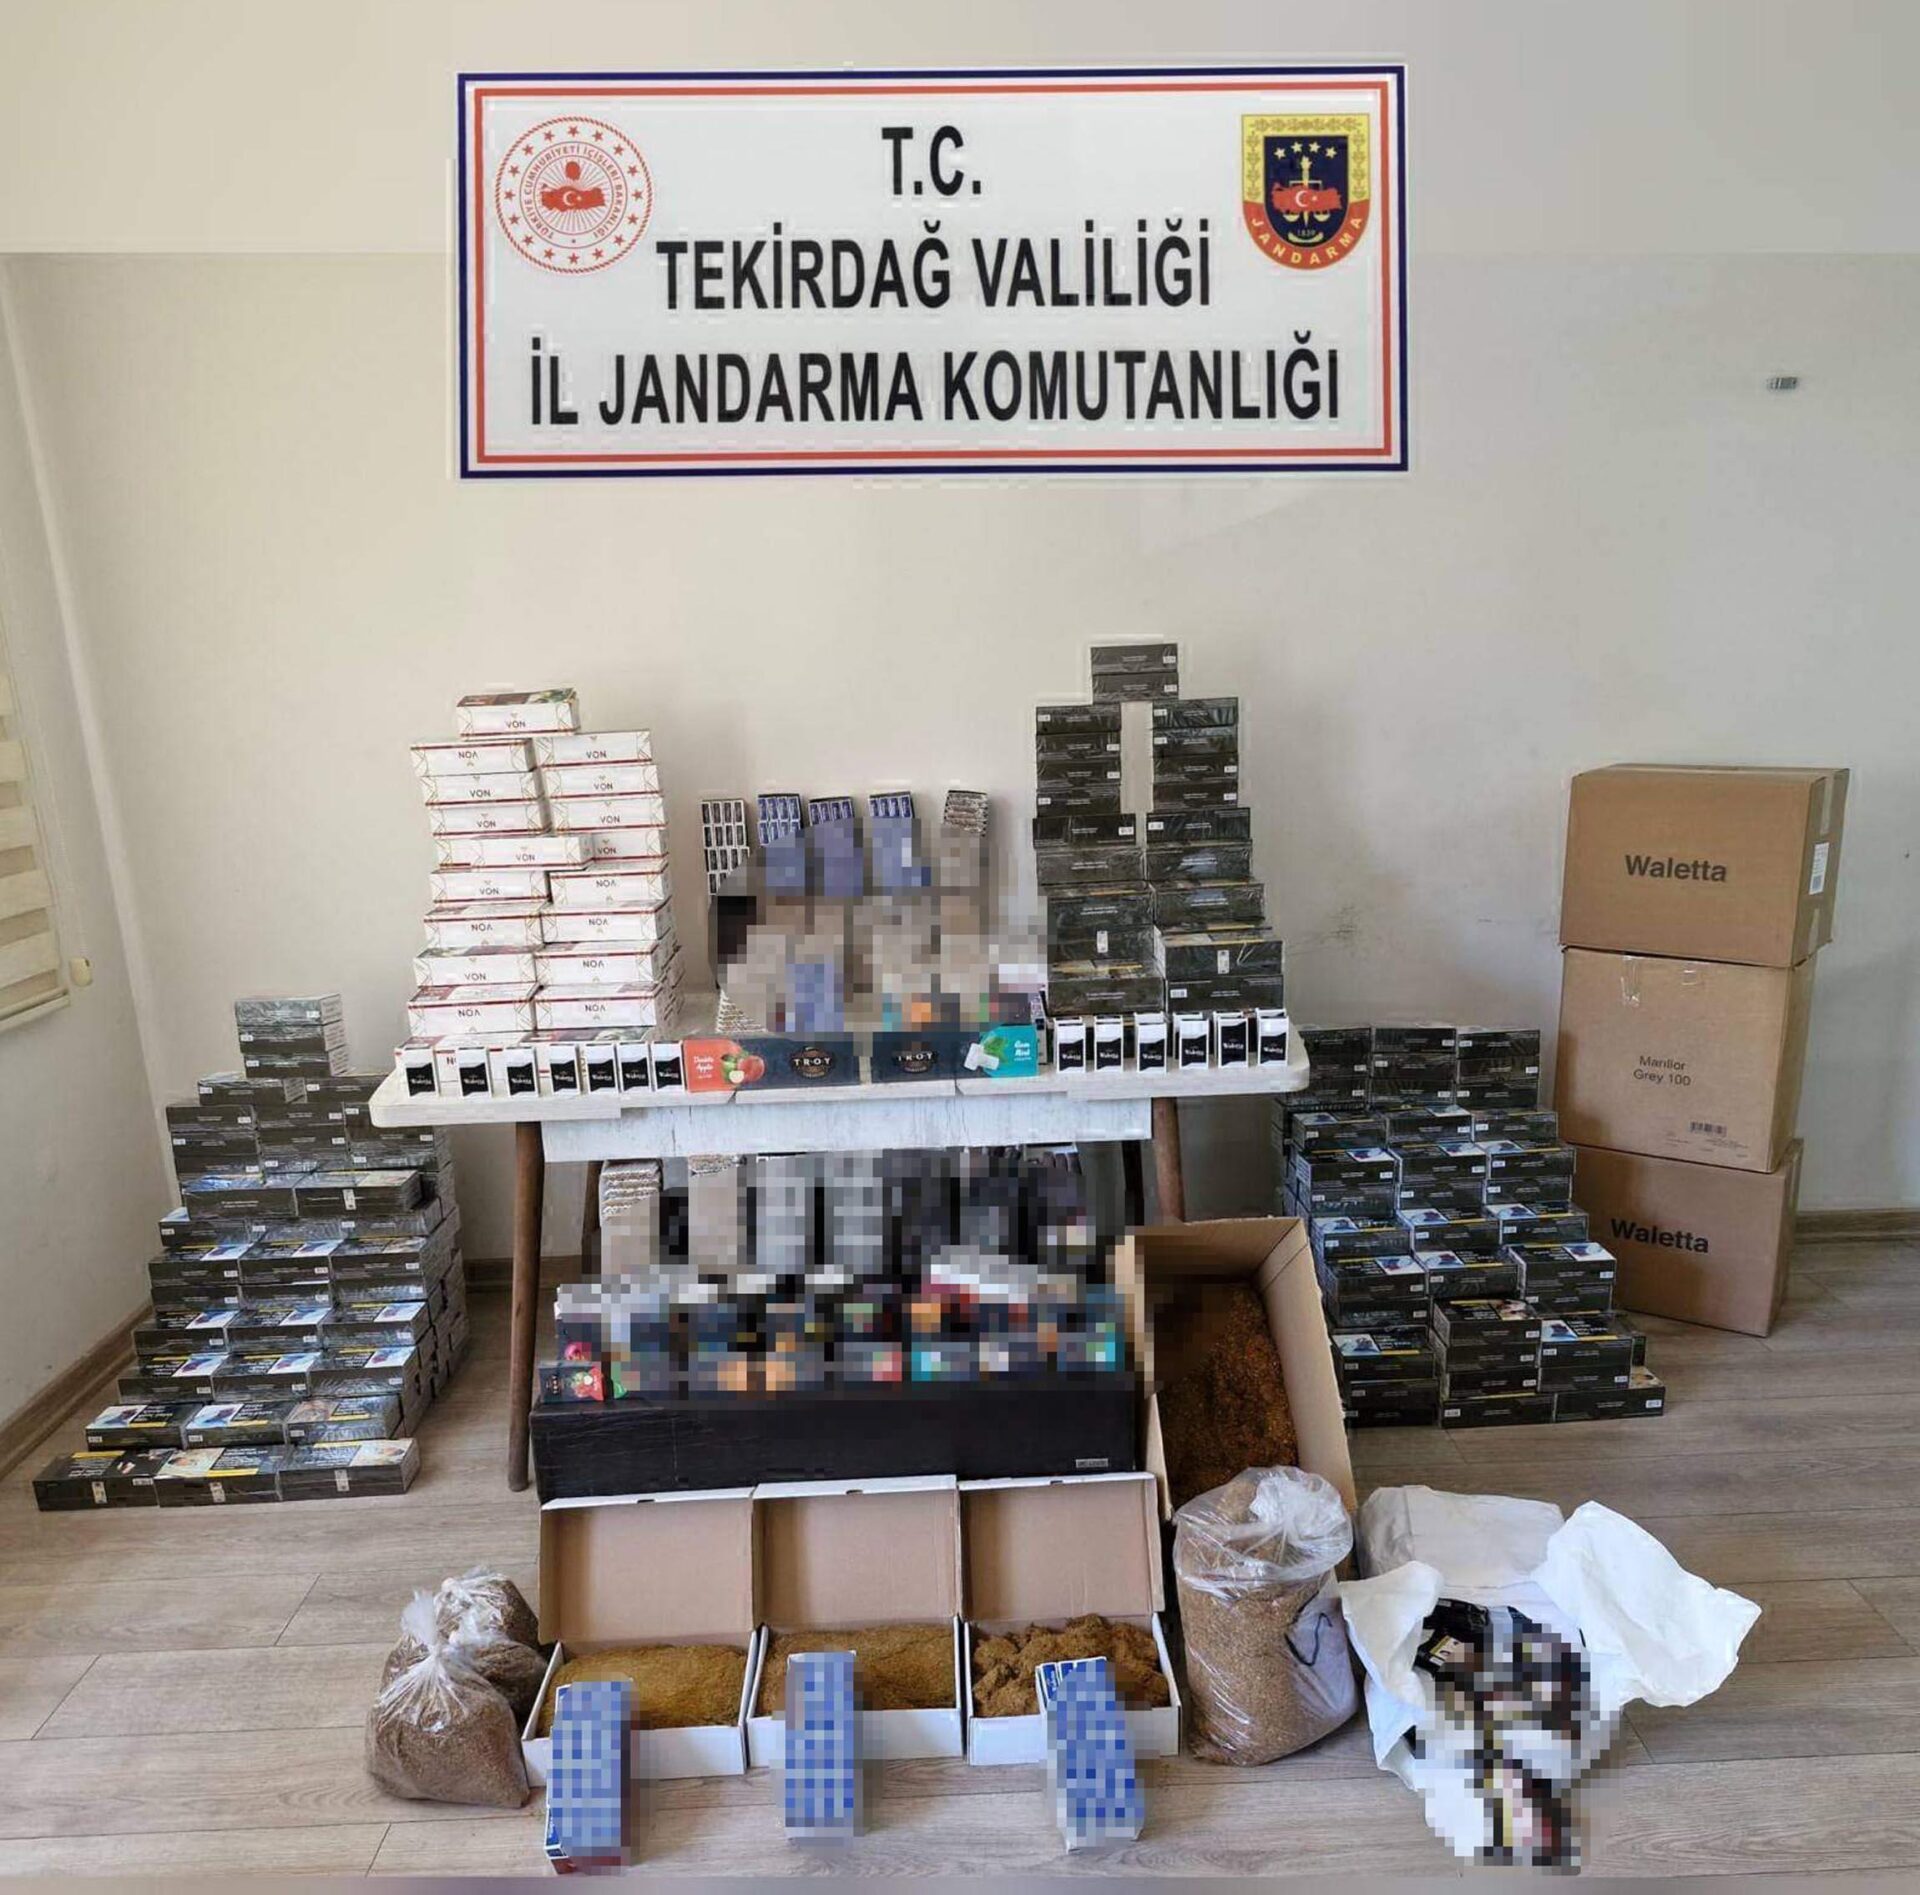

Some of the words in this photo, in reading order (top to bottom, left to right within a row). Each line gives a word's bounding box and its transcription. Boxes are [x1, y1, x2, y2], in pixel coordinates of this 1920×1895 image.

[882, 126, 981, 196] T.C.
[1252, 217, 1362, 265] JANDARMA
[656, 221, 950, 310] TEKİRDAĞ
[972, 219, 1210, 307] VALİLİĞİ
[531, 337, 579, 425] İL
[600, 352, 924, 426] JANDARMA
[944, 331, 1338, 422] KOMUTANLIĞI
[1625, 854, 1727, 883] Waletta
[793, 1057, 831, 1066] TROY
[1633, 1068, 1664, 1085] Grey
[1669, 1073, 1692, 1086] 100
[1611, 1218, 1709, 1253] Waletta
